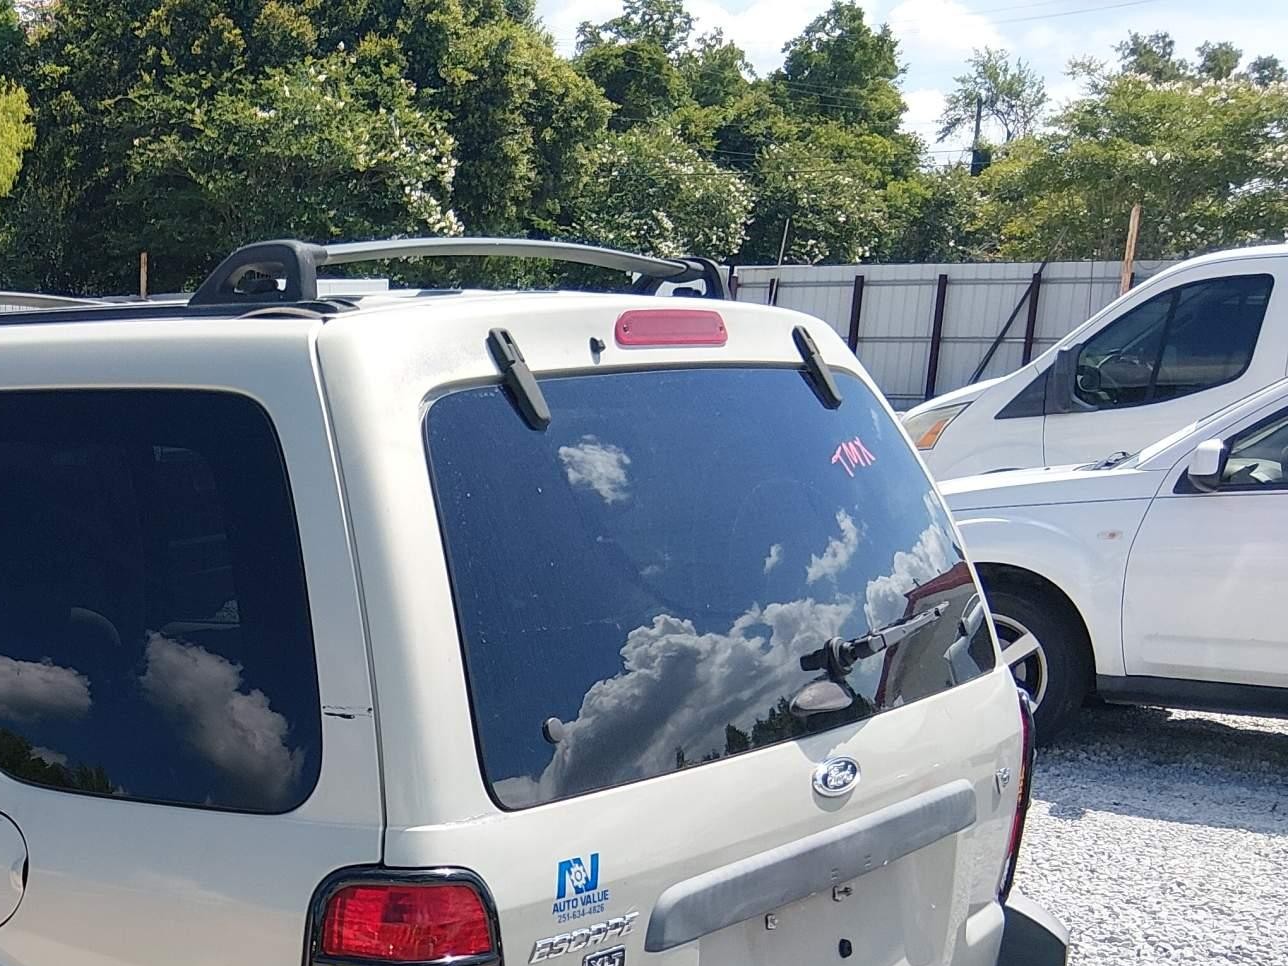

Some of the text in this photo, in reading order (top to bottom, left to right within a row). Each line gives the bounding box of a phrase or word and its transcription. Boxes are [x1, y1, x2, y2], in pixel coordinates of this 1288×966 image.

[552, 889, 609, 915] AUTO VALUE
[528, 911, 640, 964] ESCAPE
